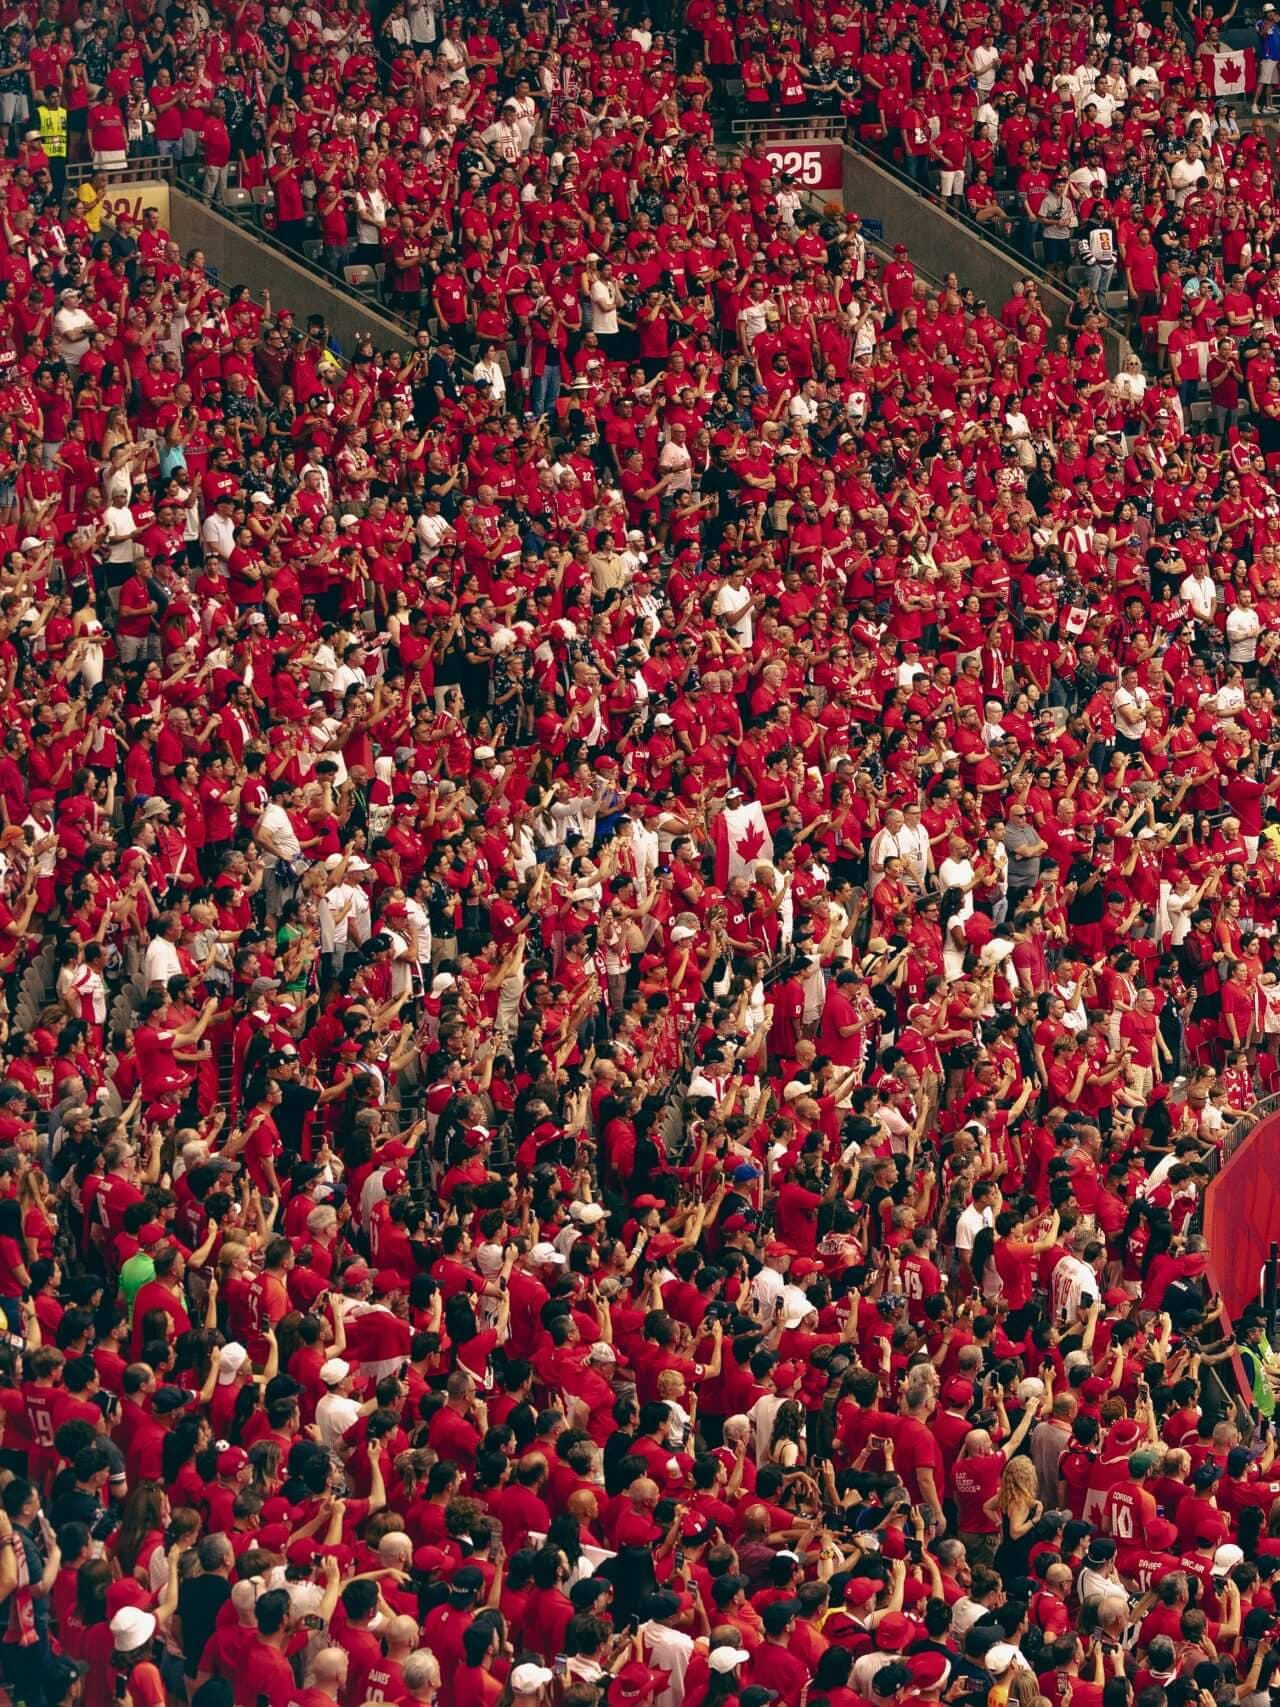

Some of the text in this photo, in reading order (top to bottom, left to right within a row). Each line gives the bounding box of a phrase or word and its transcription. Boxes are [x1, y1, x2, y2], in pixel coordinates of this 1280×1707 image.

[767, 152, 822, 185] 225
[904, 1269, 923, 1300] 19
[28, 1407, 54, 1447] 19
[1111, 1503, 1133, 1538] 10
